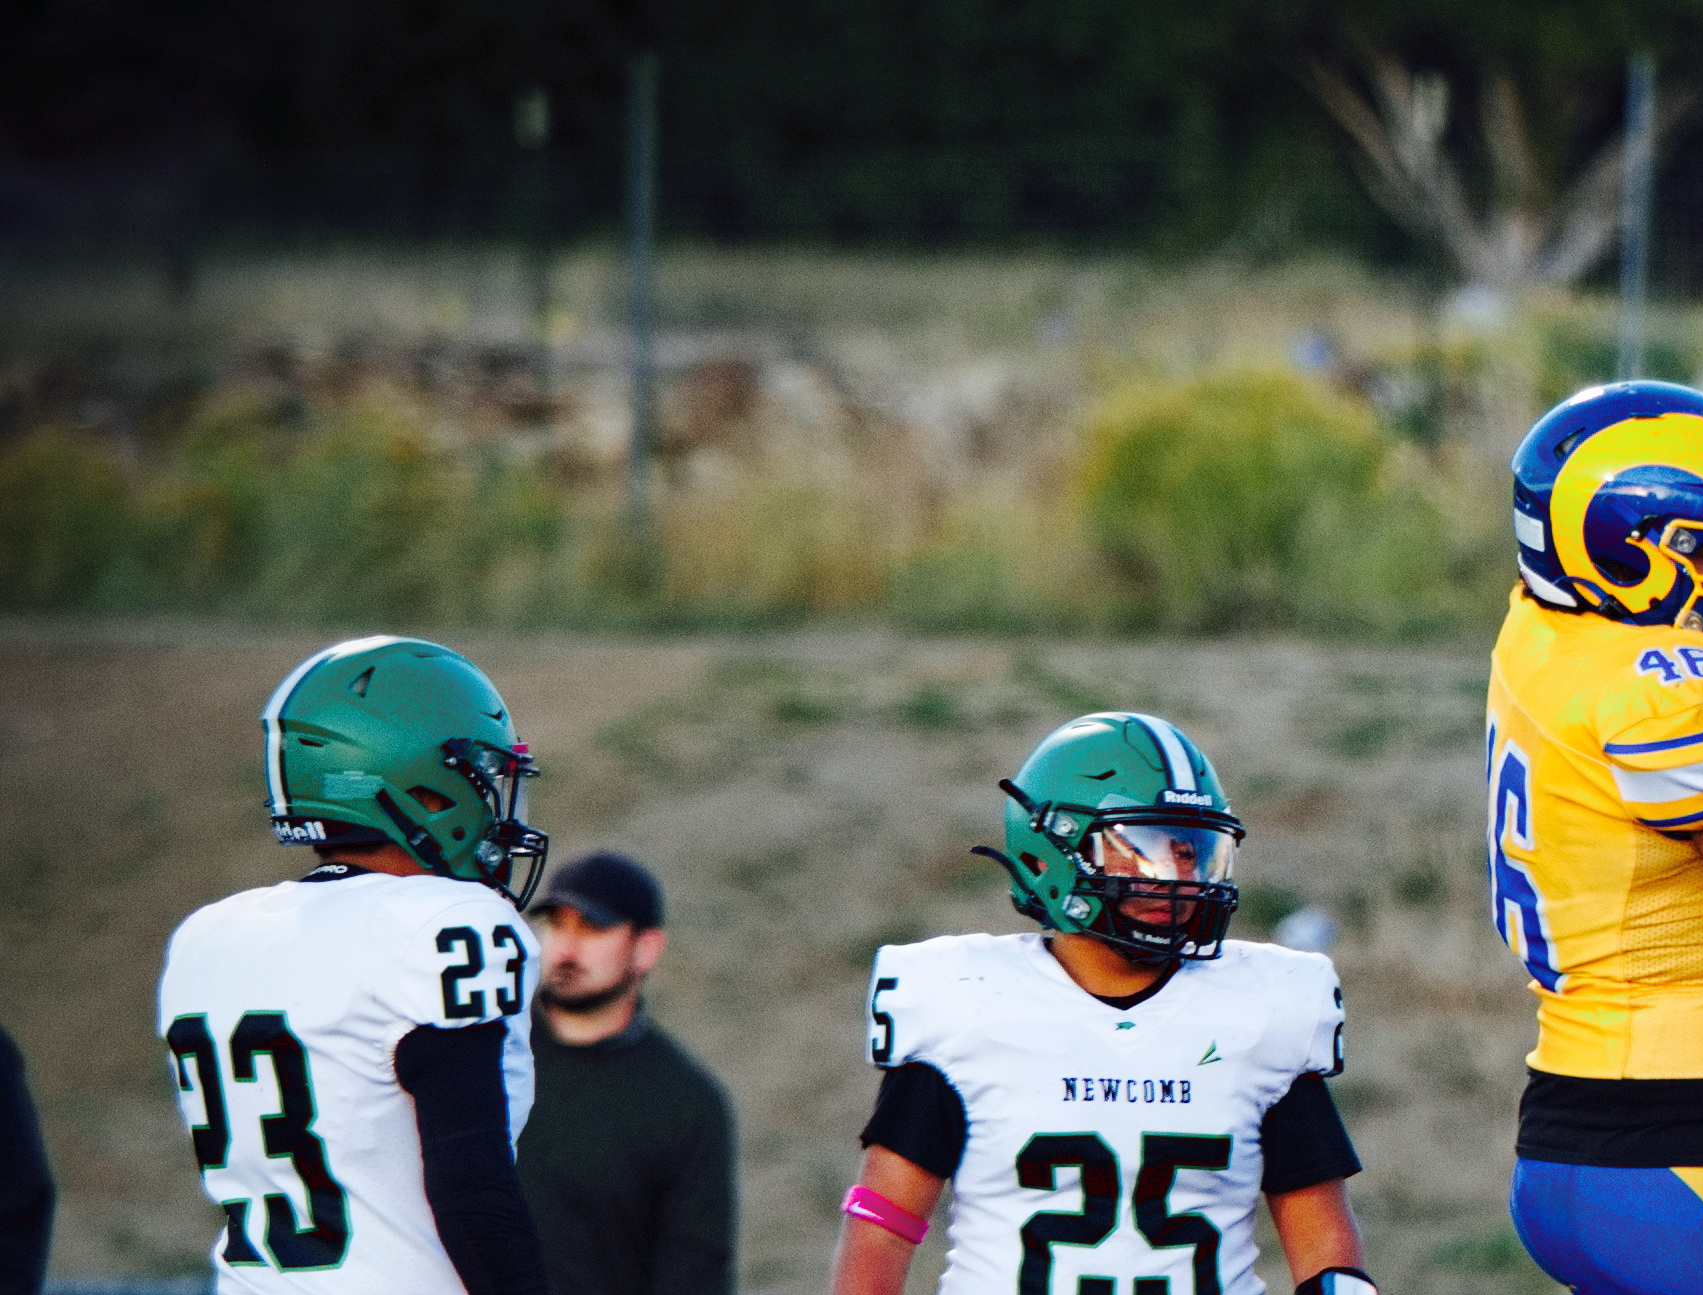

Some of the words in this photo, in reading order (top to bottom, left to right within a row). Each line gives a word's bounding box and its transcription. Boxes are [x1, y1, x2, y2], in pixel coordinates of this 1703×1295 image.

[1163, 789, 1213, 807] Riddell
[434, 923, 528, 1020] 23
[1062, 1077, 1193, 1104] NEWCOMB
[166, 1009, 354, 1273] 23
